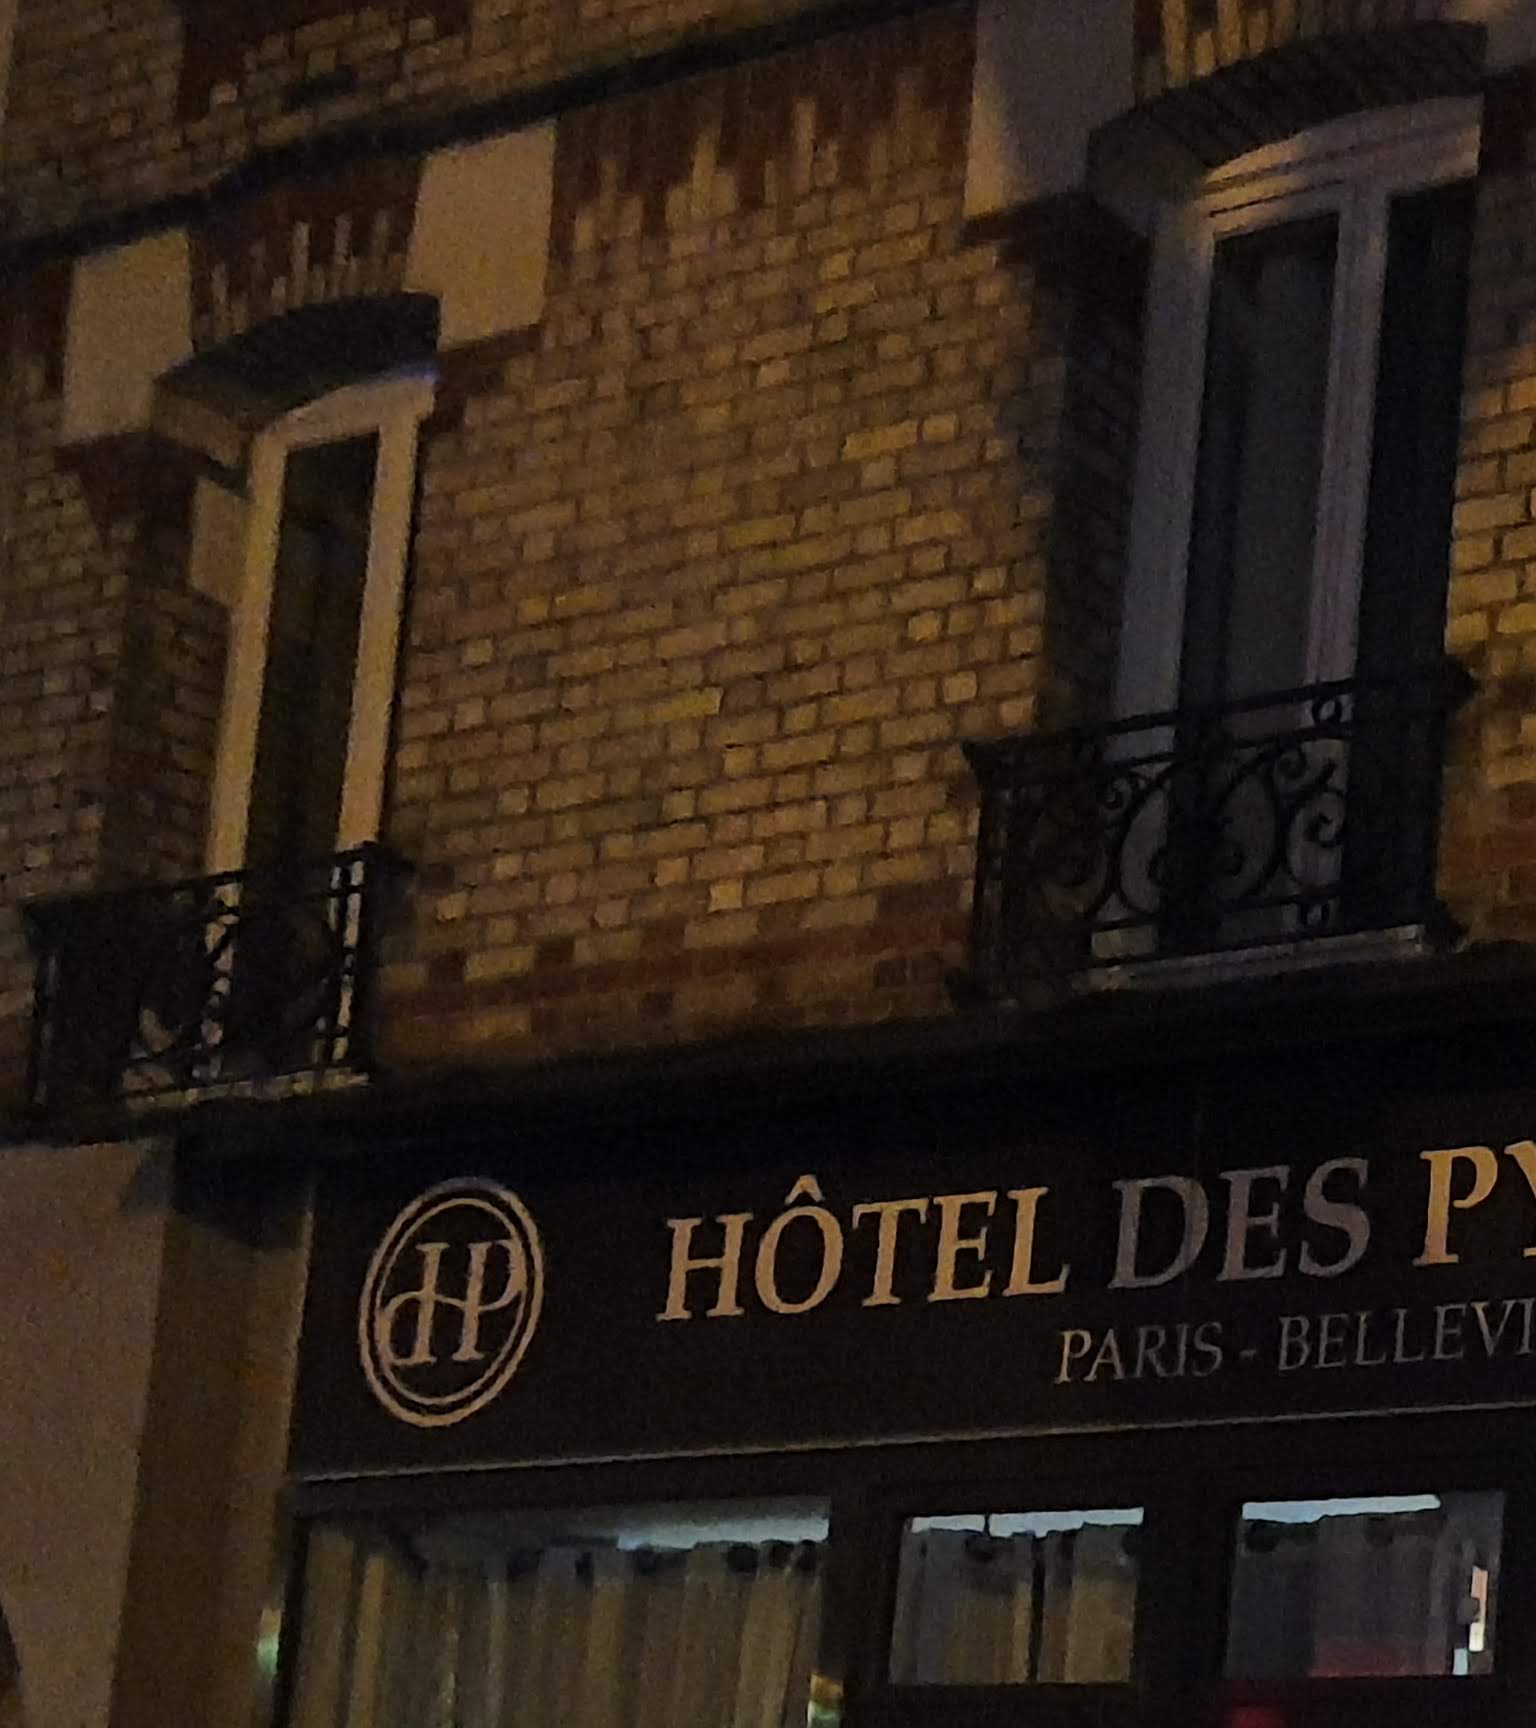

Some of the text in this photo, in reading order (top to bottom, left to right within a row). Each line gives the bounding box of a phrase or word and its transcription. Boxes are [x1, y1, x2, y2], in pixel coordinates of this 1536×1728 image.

[655, 1173, 1070, 1323] HÔTEL
[1108, 1155, 1370, 1291] DES
[1054, 1320, 1225, 1386] PARIS
